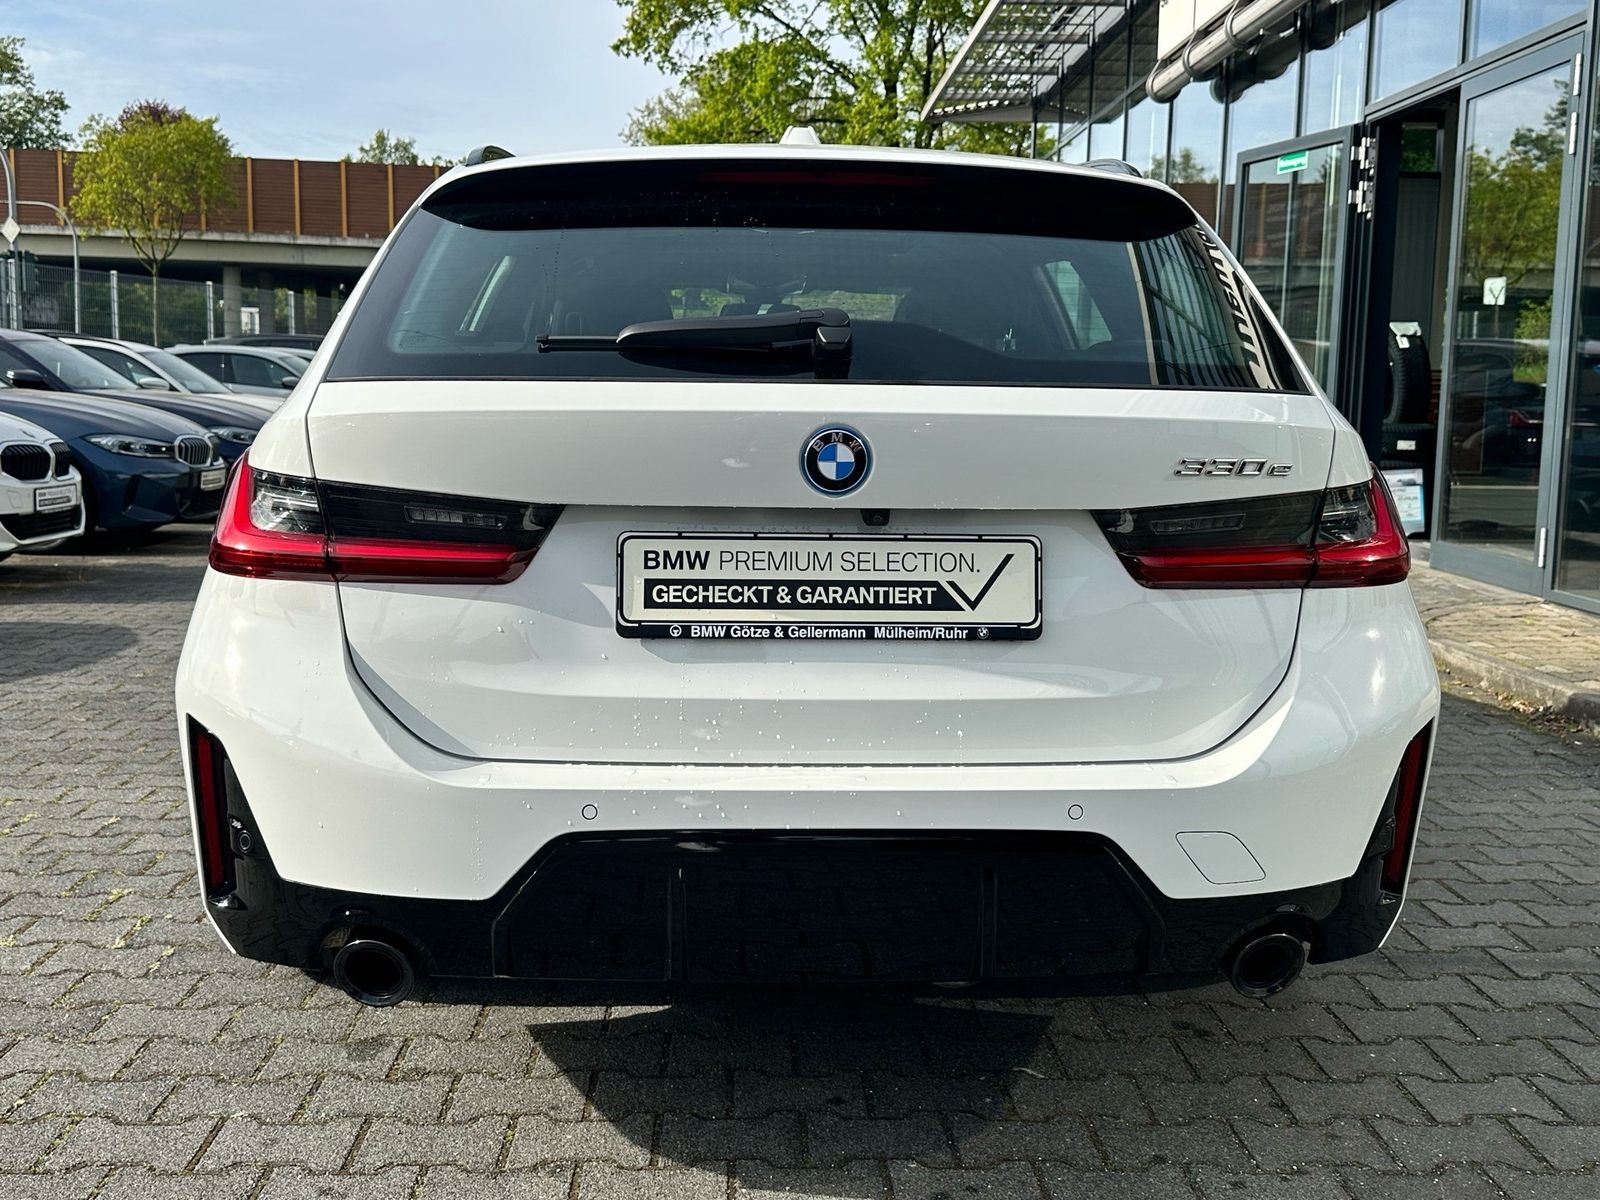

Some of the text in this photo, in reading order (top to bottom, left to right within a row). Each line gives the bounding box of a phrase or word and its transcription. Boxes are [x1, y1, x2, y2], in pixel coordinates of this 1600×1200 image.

[812, 432, 863, 453] BMW
[1173, 458, 1293, 476] 330e
[643, 550, 981, 573] BMW PREMIUM SELECTION.
[652, 584, 937, 605] GECHECKT & GARANTIERT
[690, 625, 968, 640] BMW Götze & Gellermann Mülheim/Ruhr
